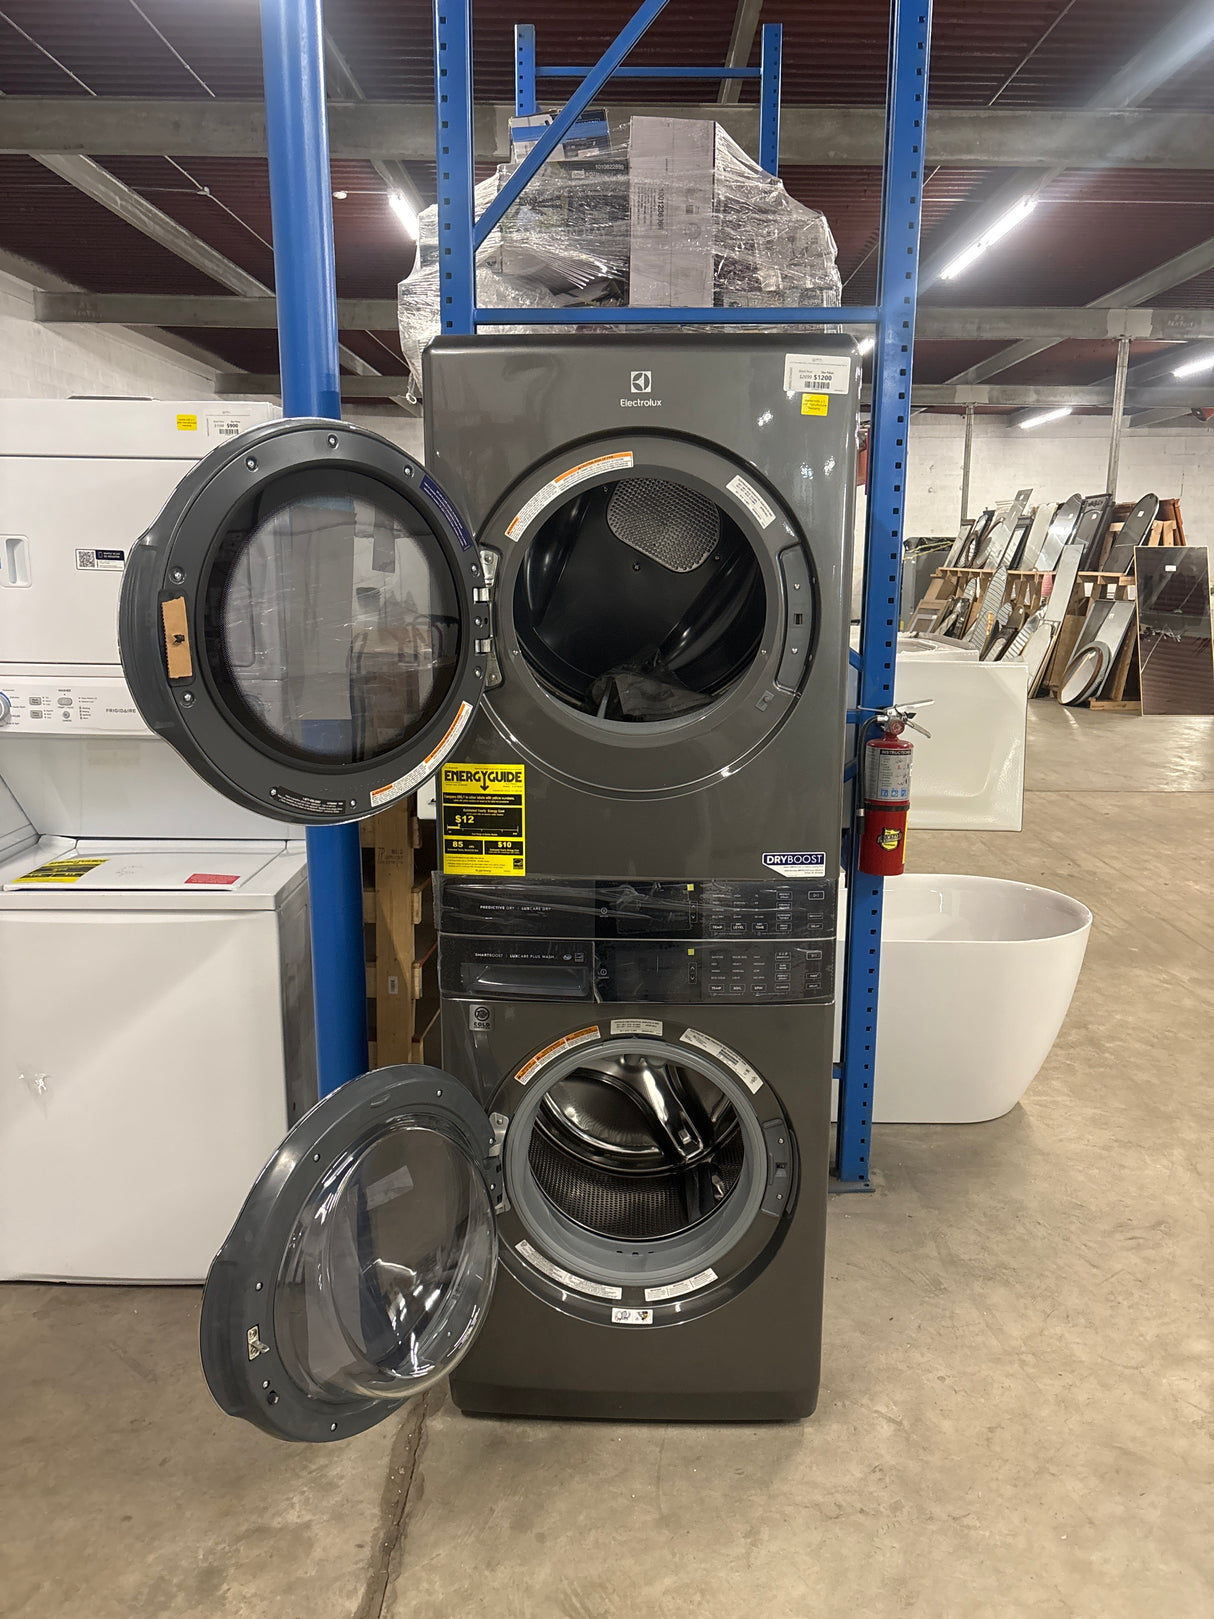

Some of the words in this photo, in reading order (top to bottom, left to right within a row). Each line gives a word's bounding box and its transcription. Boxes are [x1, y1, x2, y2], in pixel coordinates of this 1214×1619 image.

[620, 398, 662, 407] Electrolux
[455, 815, 475, 824] $12
[766, 854, 823, 864] DRYBOOST
